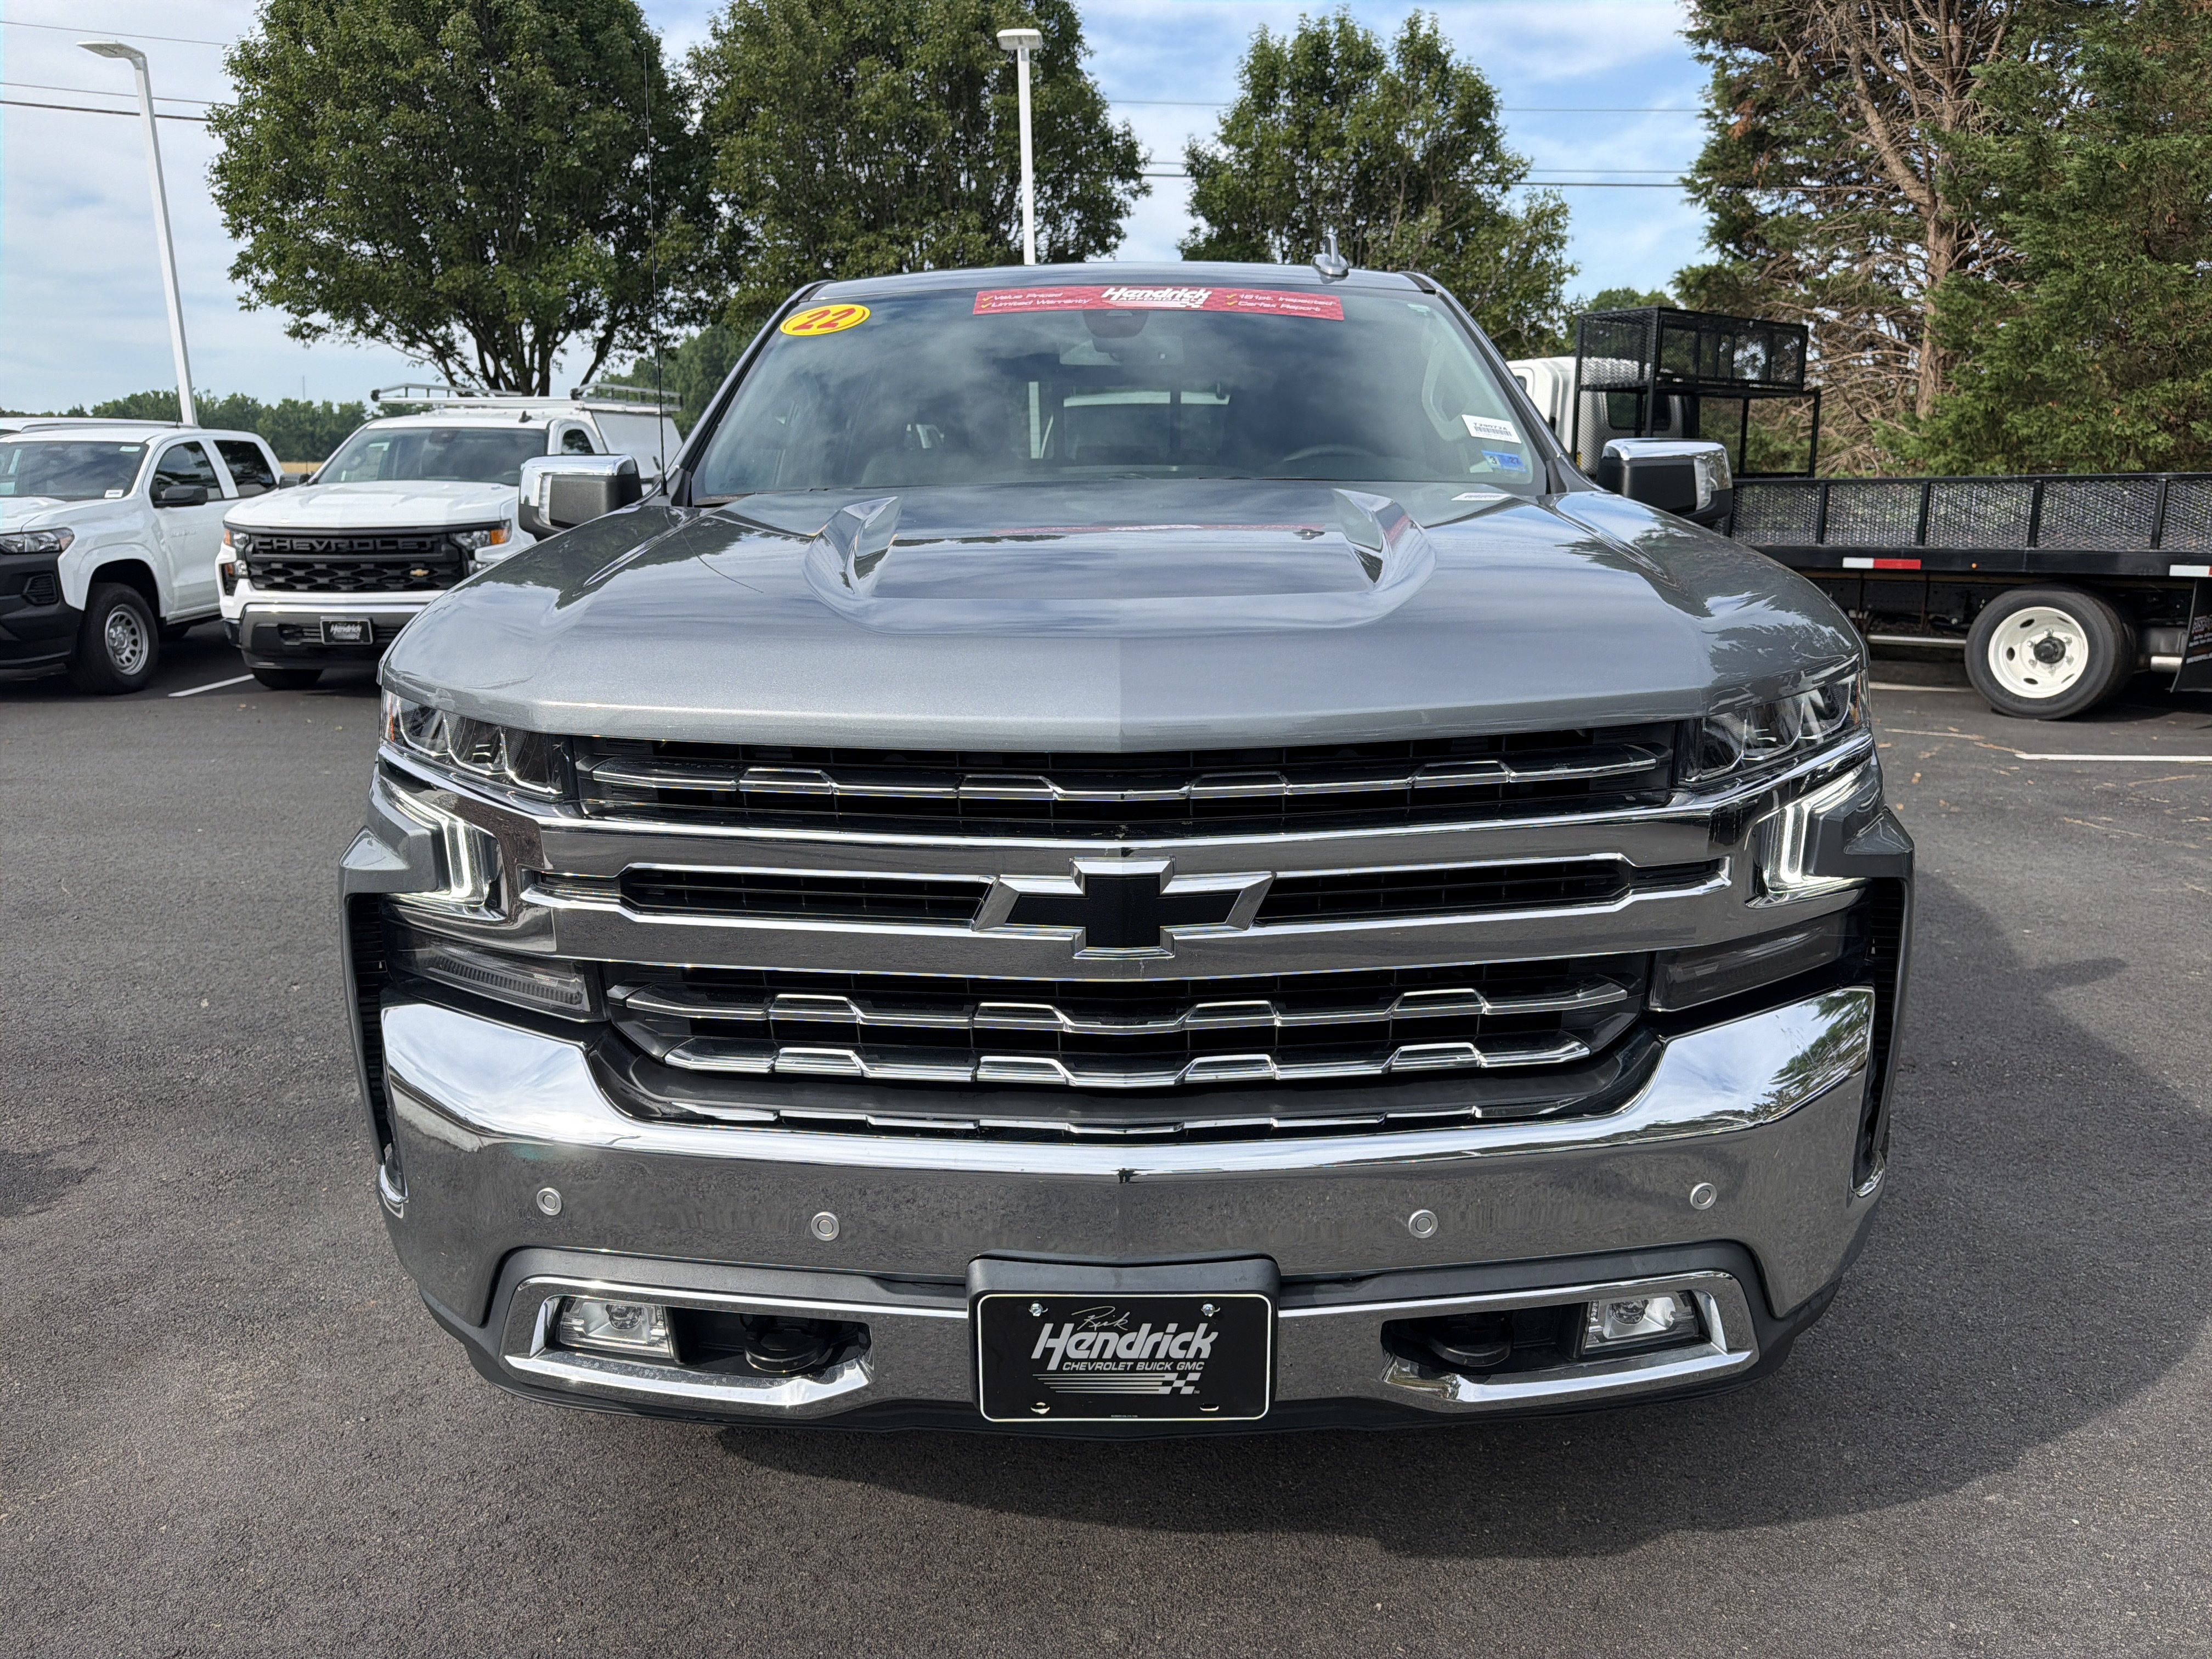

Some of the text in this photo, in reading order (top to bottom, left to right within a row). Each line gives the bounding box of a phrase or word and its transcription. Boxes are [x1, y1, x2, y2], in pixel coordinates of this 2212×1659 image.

[1101, 287, 1212, 301] Hendrick
[1279, 303, 1321, 312] Report
[792, 308, 856, 331] 22
[255, 538, 438, 551] CHEVROLET
[1030, 1322, 1219, 1371] Hendrick
[1062, 1362, 1205, 1370] CHEVROLET BUICK GMC
